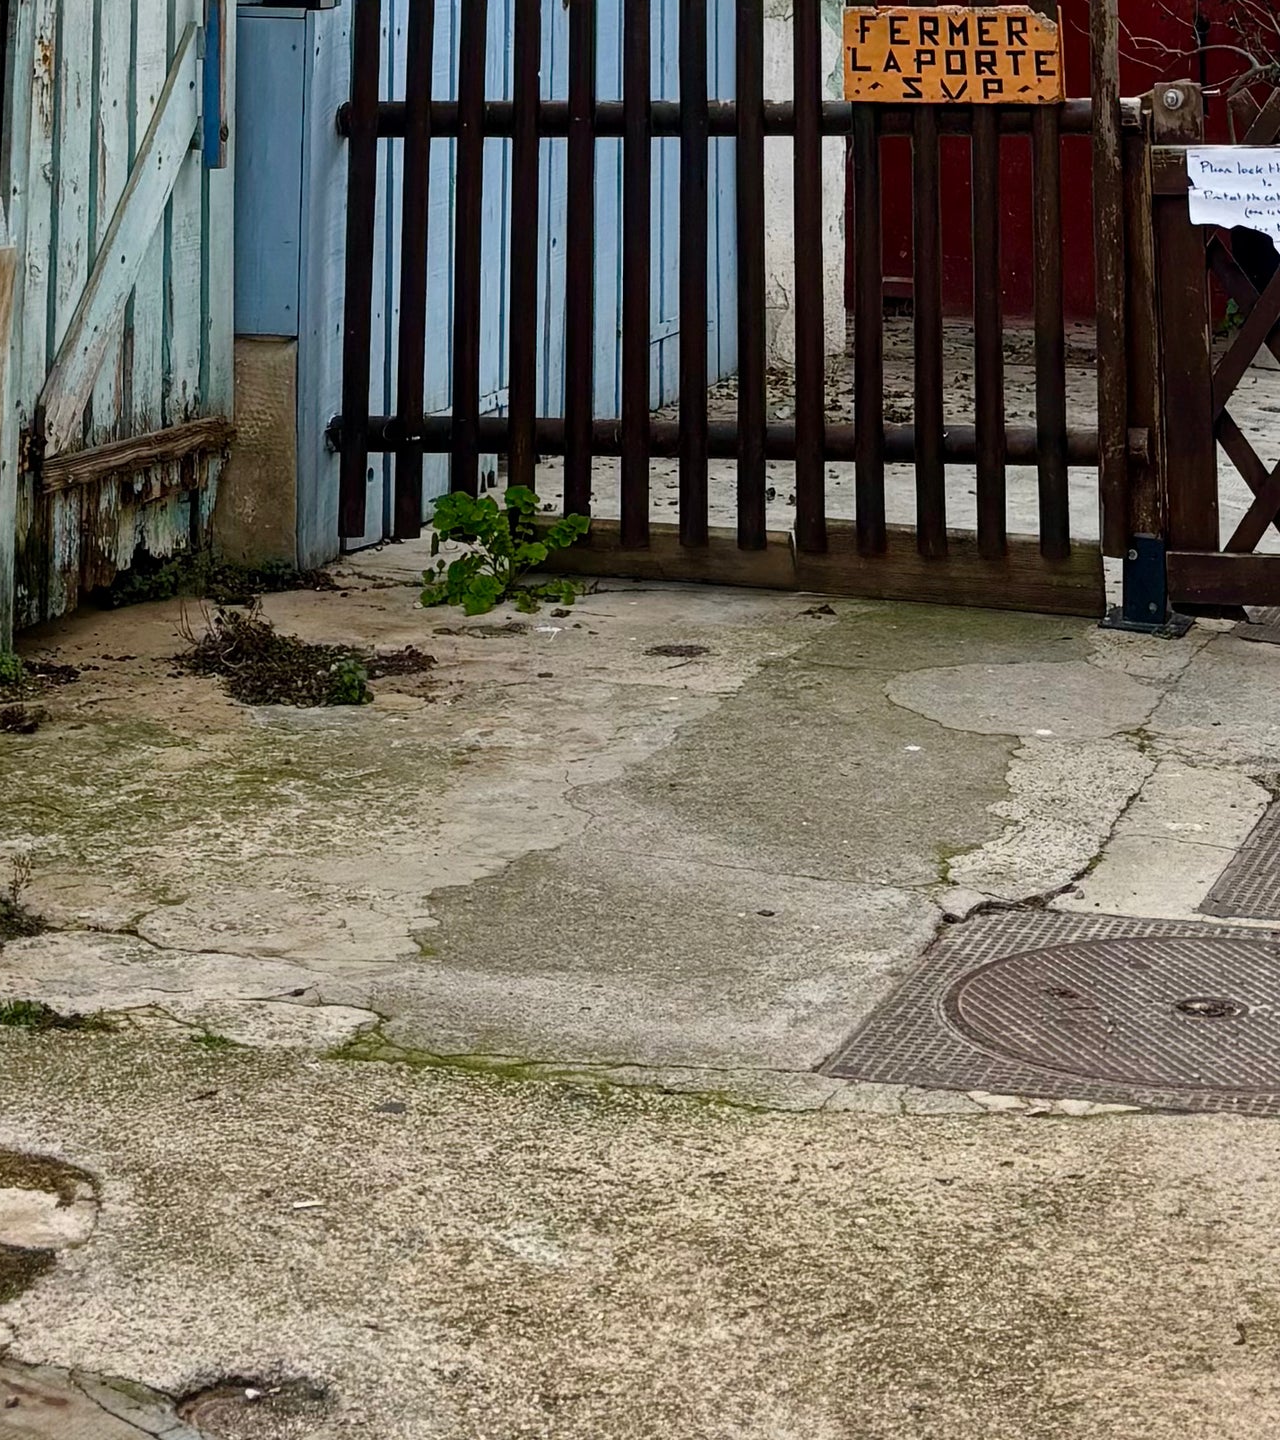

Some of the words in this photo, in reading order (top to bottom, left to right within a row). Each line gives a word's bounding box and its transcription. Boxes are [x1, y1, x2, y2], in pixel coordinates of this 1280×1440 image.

[858, 15, 1028, 46] FERMER
[902, 77, 1004, 100] SVP
[1236, 161, 1264, 175] lock
